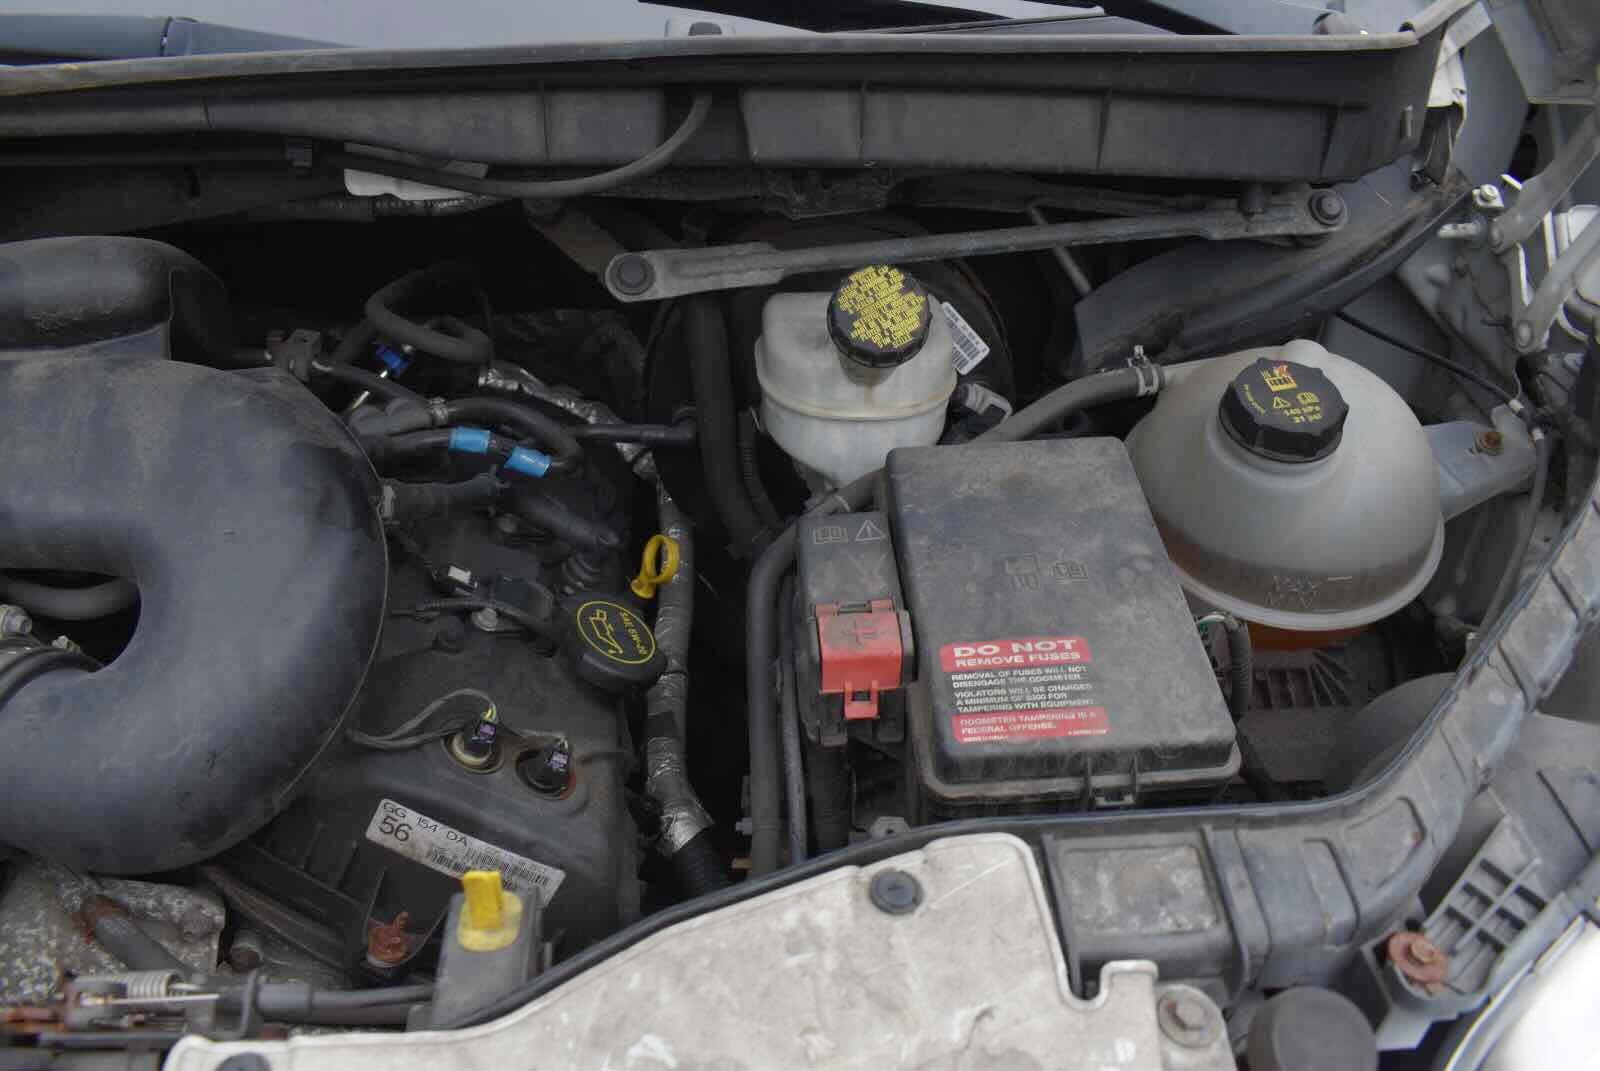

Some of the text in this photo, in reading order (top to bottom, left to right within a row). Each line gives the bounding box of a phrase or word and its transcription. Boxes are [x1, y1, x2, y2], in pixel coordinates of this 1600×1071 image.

[953, 639, 1077, 658] DO NOT
[955, 652, 1081, 668] REMOVE FUSES
[951, 665, 1088, 682] REMOVAL OF FUSES WILL NOT
[953, 678, 1006, 689] DISENGAGE
[1008, 676, 1027, 684] THE
[954, 683, 1093, 699] VIOLATORS WILL BE CHARGED
[964, 695, 1009, 705] MINIMUM
[1048, 692, 1068, 700] FOR
[958, 703, 1012, 713] TAMPERING
[1015, 701, 1039, 710] WITH
[960, 715, 1016, 726] ODOMETER
[1018, 712, 1076, 723] TAMPERING
[961, 724, 1007, 735] FEDERAL
[379, 816, 412, 842] 56
[416, 816, 439, 833] 154
